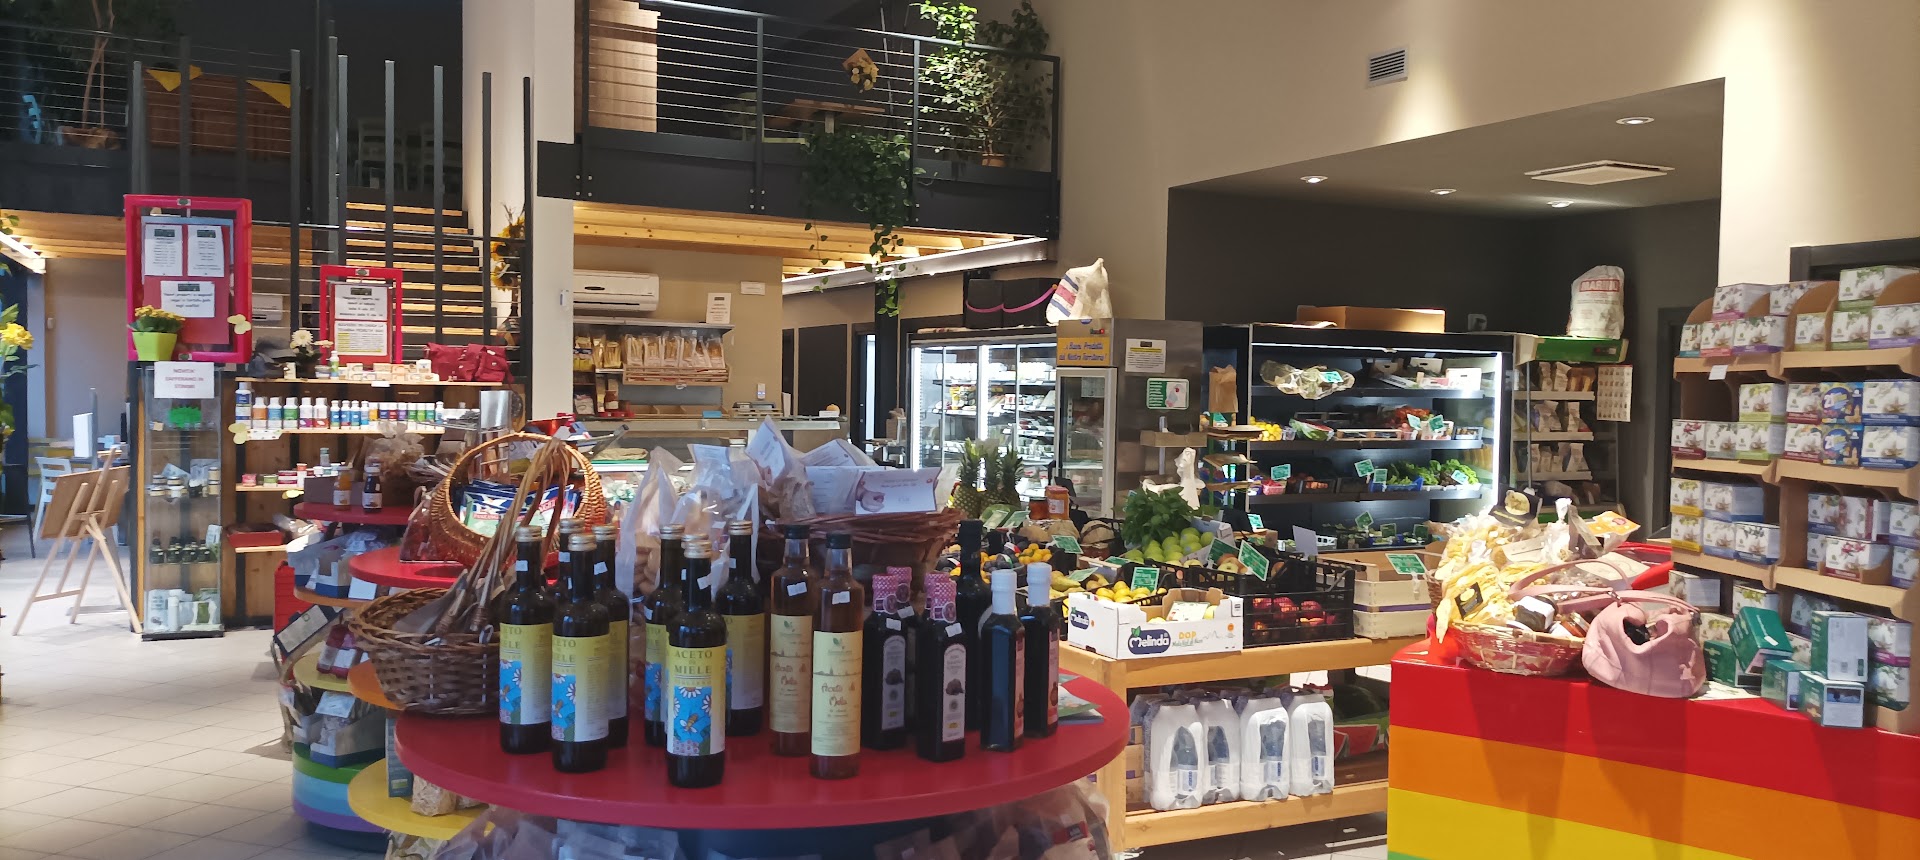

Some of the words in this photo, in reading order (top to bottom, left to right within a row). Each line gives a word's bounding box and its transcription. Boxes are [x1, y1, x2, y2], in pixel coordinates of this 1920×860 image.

[1178, 631, 1197, 639] DOP
[1129, 632, 1170, 649] Melinda
[674, 650, 712, 658] ACETO
[674, 665, 712, 674] MIELE
